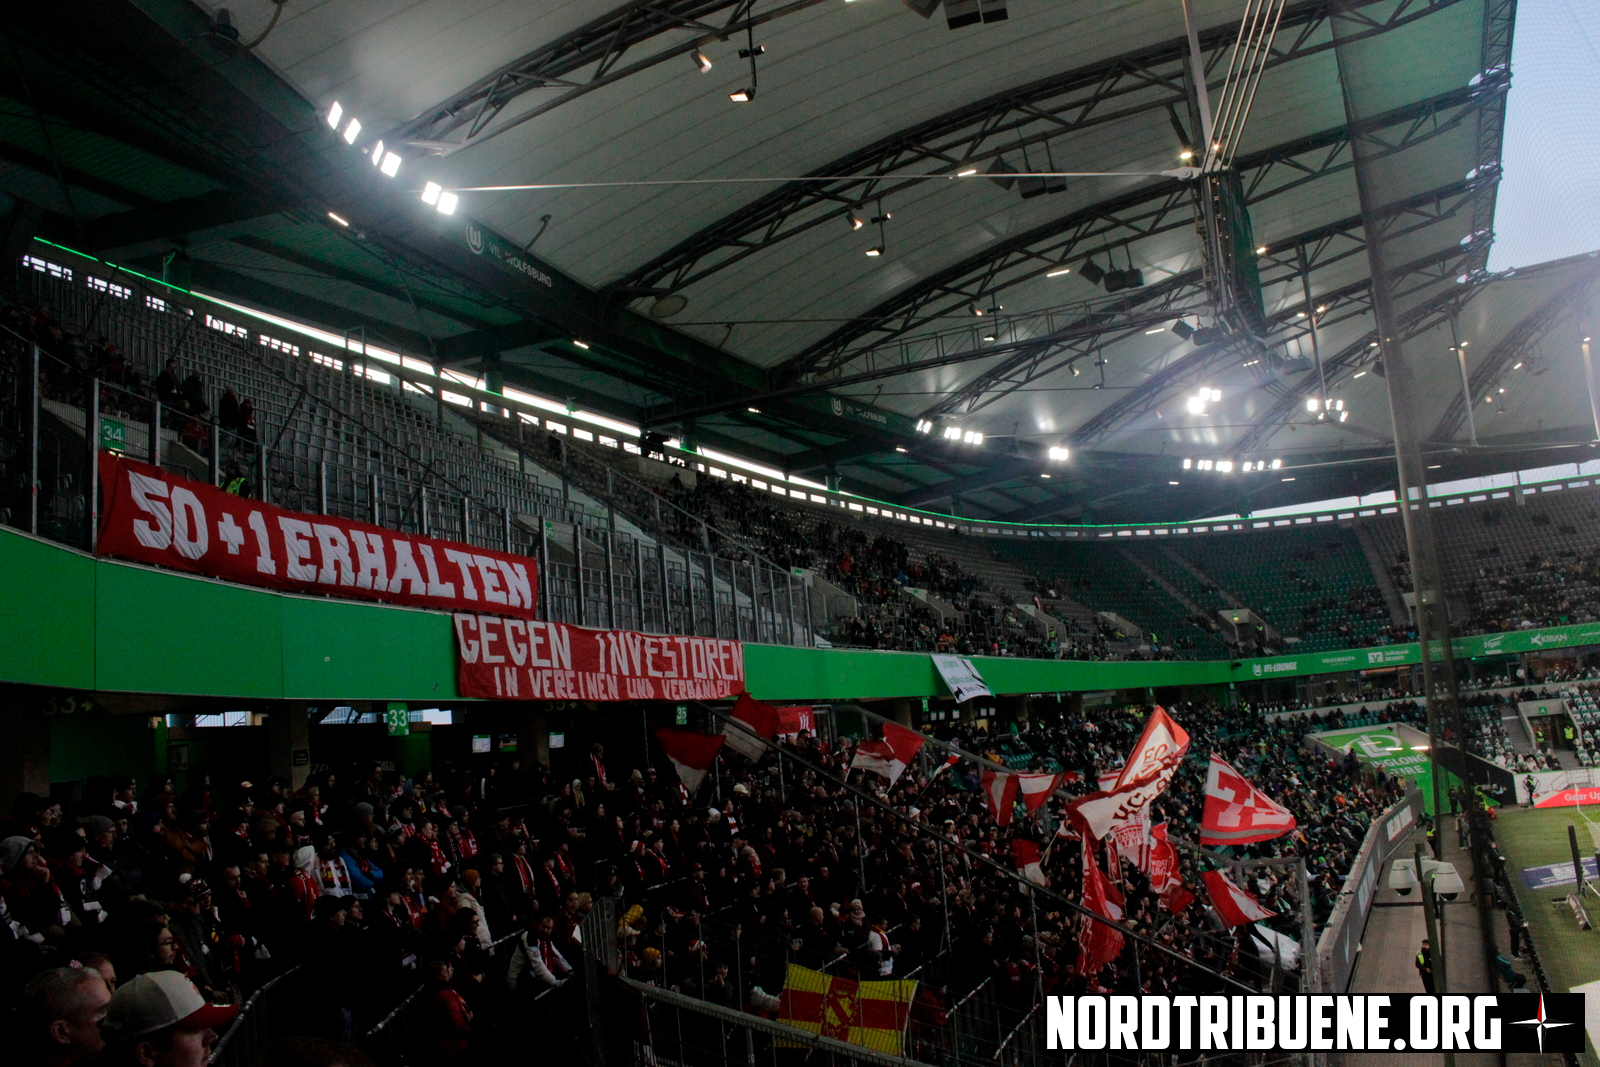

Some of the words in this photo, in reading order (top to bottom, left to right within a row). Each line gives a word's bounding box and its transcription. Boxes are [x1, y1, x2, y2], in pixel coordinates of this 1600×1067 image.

[104, 425, 123, 443] 34
[277, 515, 533, 610] ERHALTEN
[453, 612, 572, 670] GEGEN
[594, 629, 744, 681] INVESTOREN
[494, 666, 518, 697] IN
[528, 669, 620, 700] VEREINEN
[626, 677, 655, 698] UND
[389, 709, 408, 727] 33
